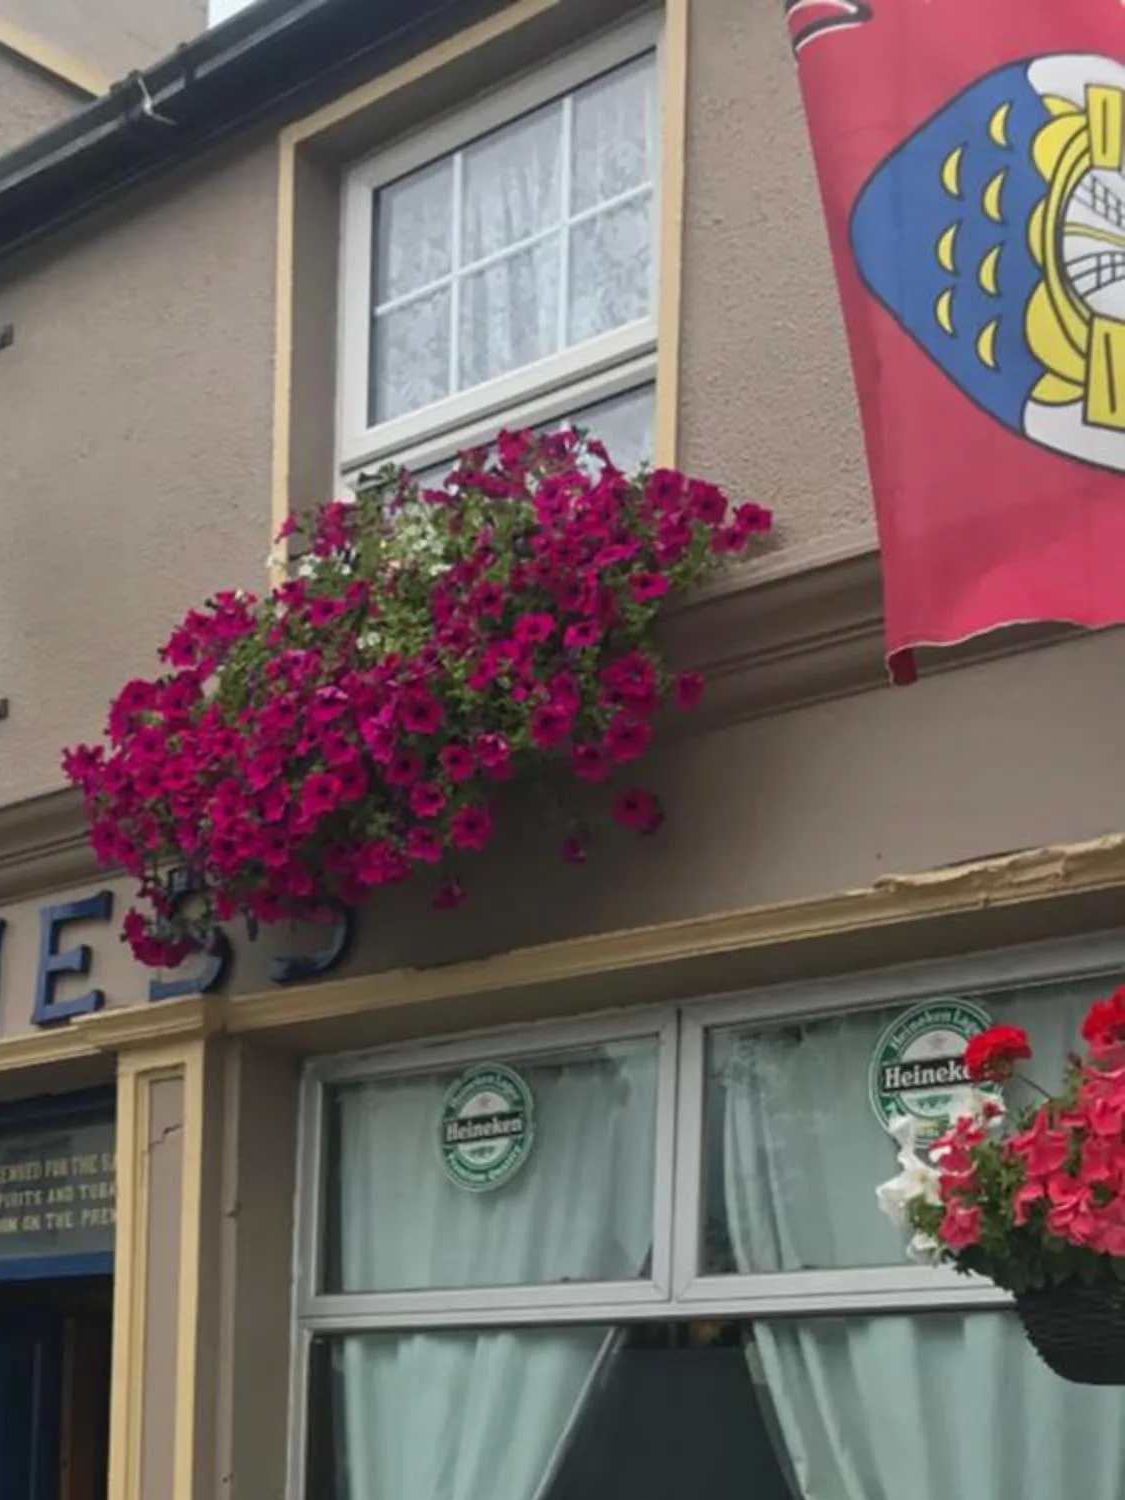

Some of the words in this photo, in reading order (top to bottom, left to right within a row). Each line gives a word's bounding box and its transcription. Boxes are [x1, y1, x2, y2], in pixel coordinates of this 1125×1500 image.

[884, 1058, 973, 1089] Heineke
[446, 1116, 522, 1142] Heineken
[70, 1153, 98, 1176] THE
[47, 1185, 74, 1203] AND
[45, 1210, 74, 1229] THE
